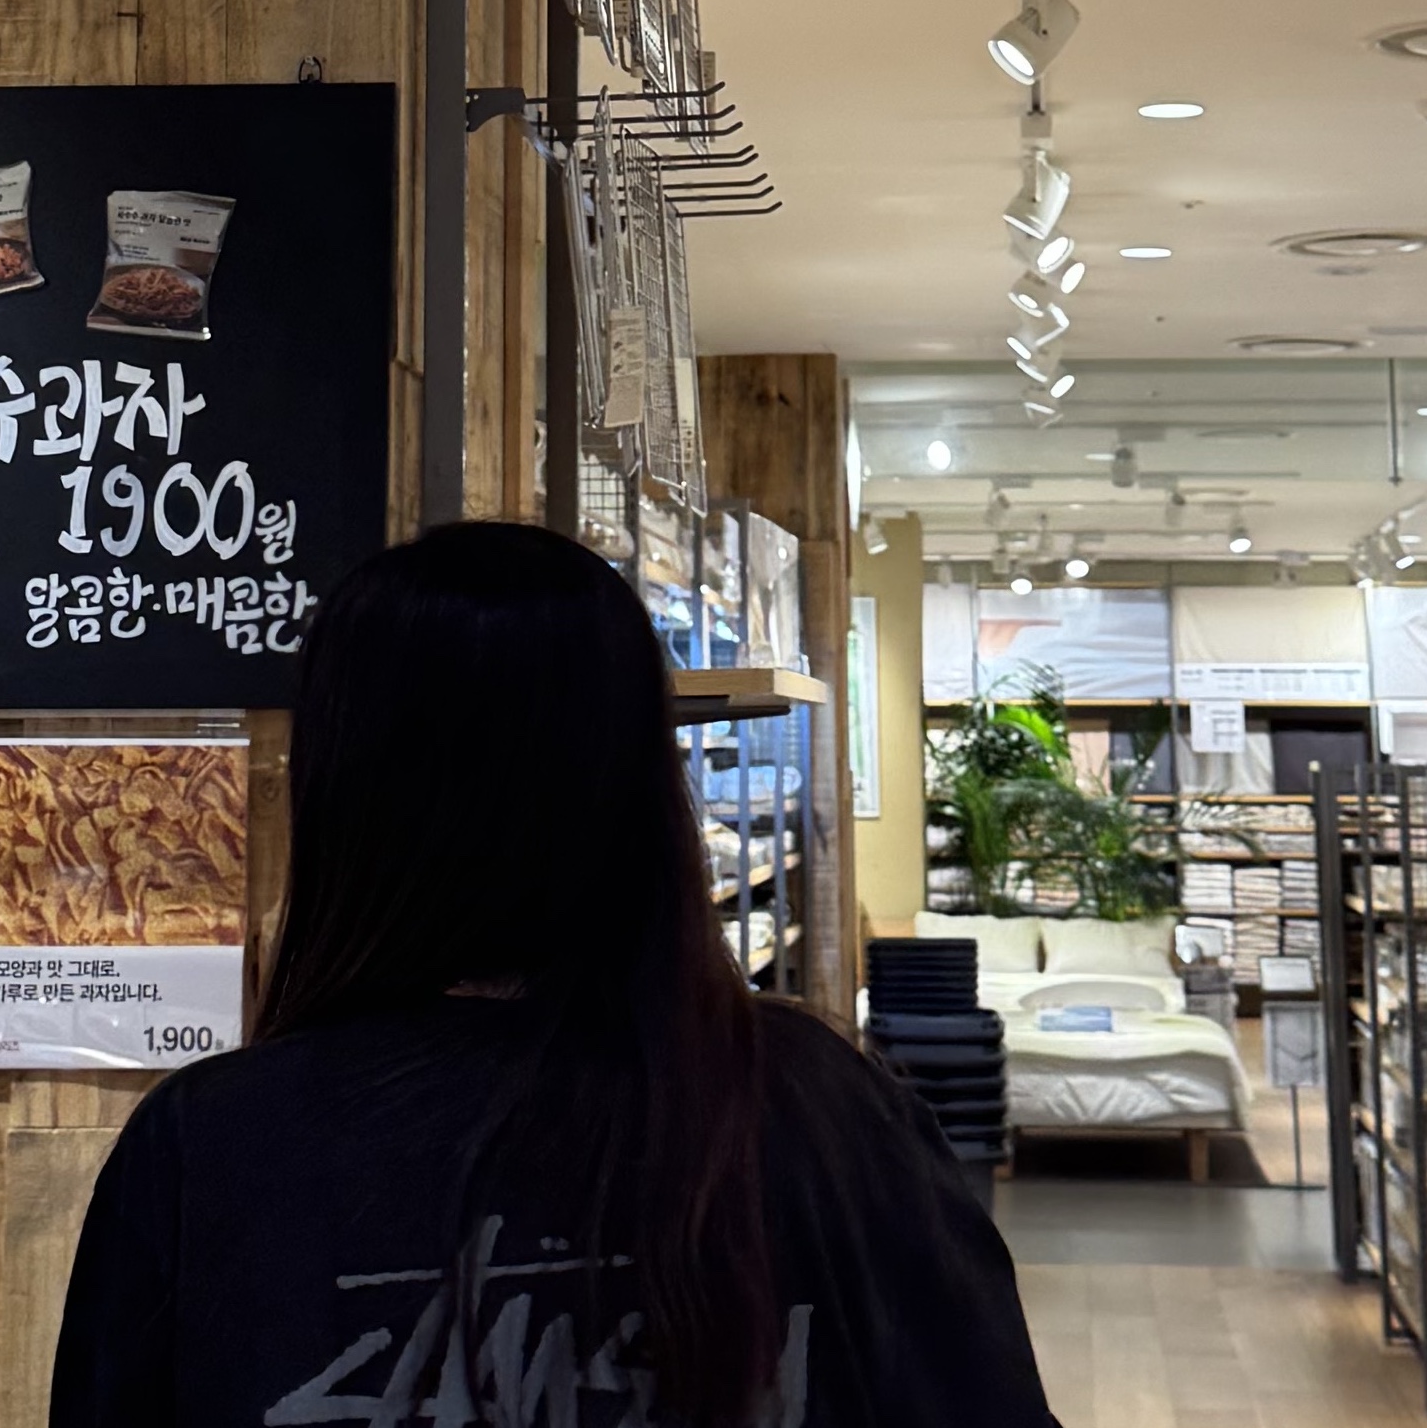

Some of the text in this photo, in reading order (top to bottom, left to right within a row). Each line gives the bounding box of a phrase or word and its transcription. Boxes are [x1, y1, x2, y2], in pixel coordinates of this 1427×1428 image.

[47, 959, 64, 979] 맛
[68, 959, 121, 979] 그대로.
[42, 983, 75, 1003] 만든
[79, 983, 163, 1003] 과자입니다.
